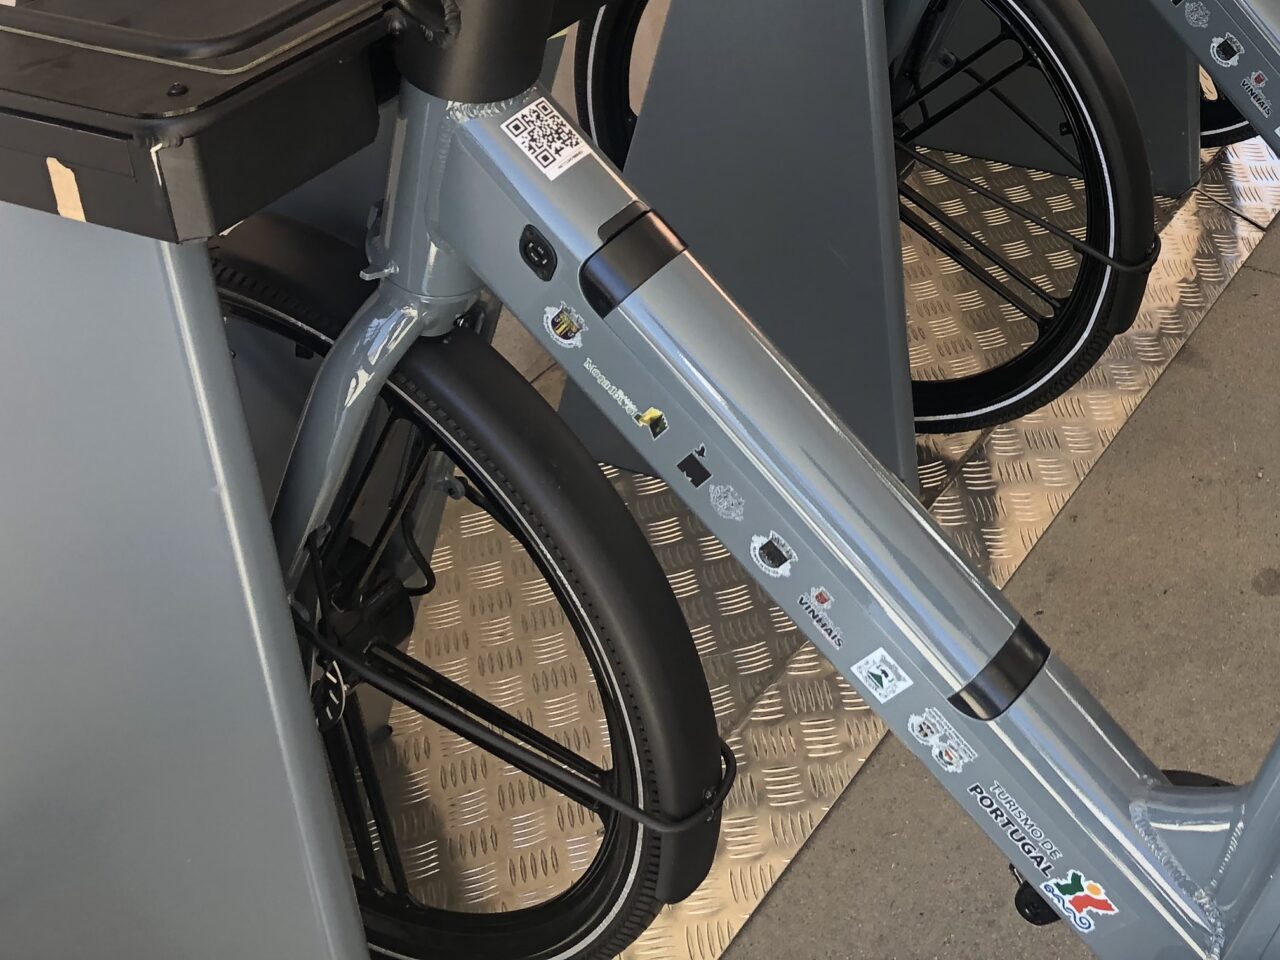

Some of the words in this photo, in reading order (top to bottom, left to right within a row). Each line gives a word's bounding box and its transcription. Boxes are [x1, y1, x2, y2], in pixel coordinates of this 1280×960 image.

[1241, 79, 1272, 116] VINHAIS
[799, 596, 843, 649] VINHAIS
[969, 783, 1054, 877] PORTUGAL
[990, 781, 1044, 839] TURISMO
[1041, 840, 1062, 860] DE
